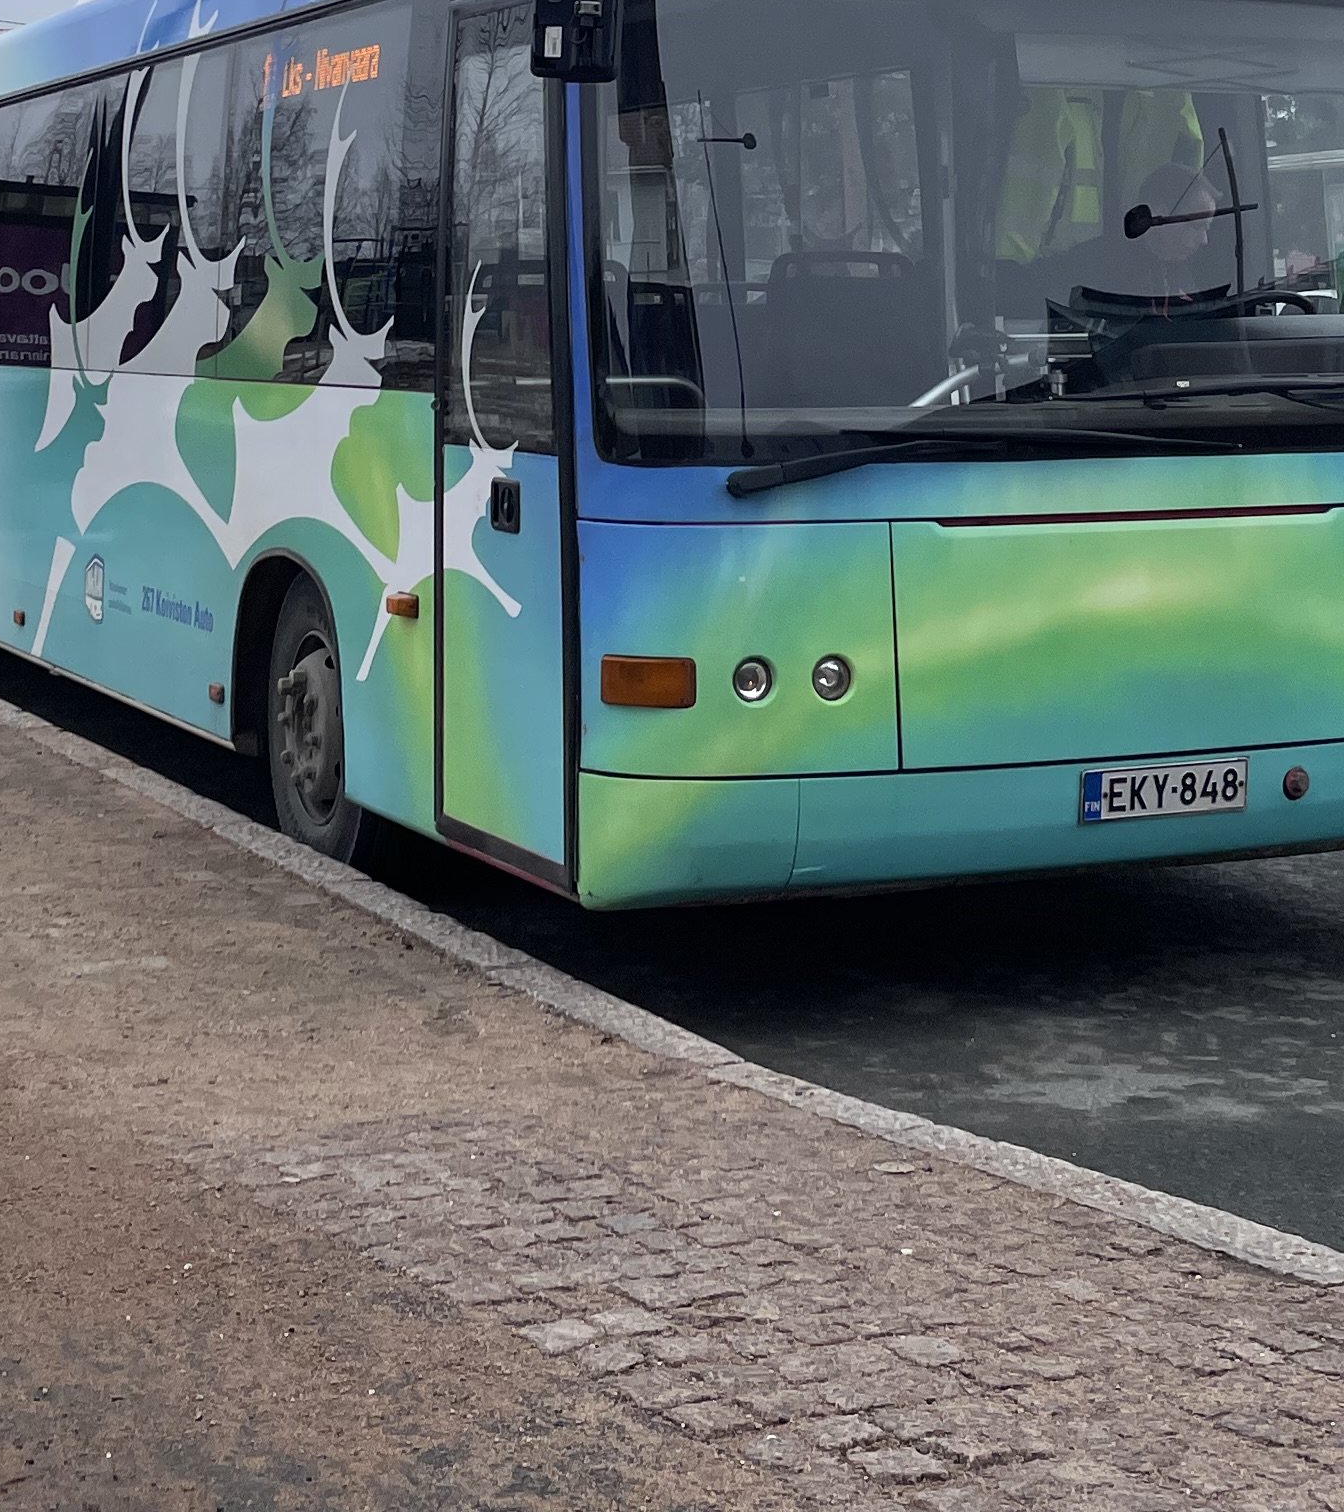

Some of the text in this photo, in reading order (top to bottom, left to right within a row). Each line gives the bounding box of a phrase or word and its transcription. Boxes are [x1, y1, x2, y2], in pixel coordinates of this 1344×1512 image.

[193, 600, 214, 633] Auto
[1084, 800, 1101, 813] FIN
[1108, 767, 1239, 813] EKY-848
